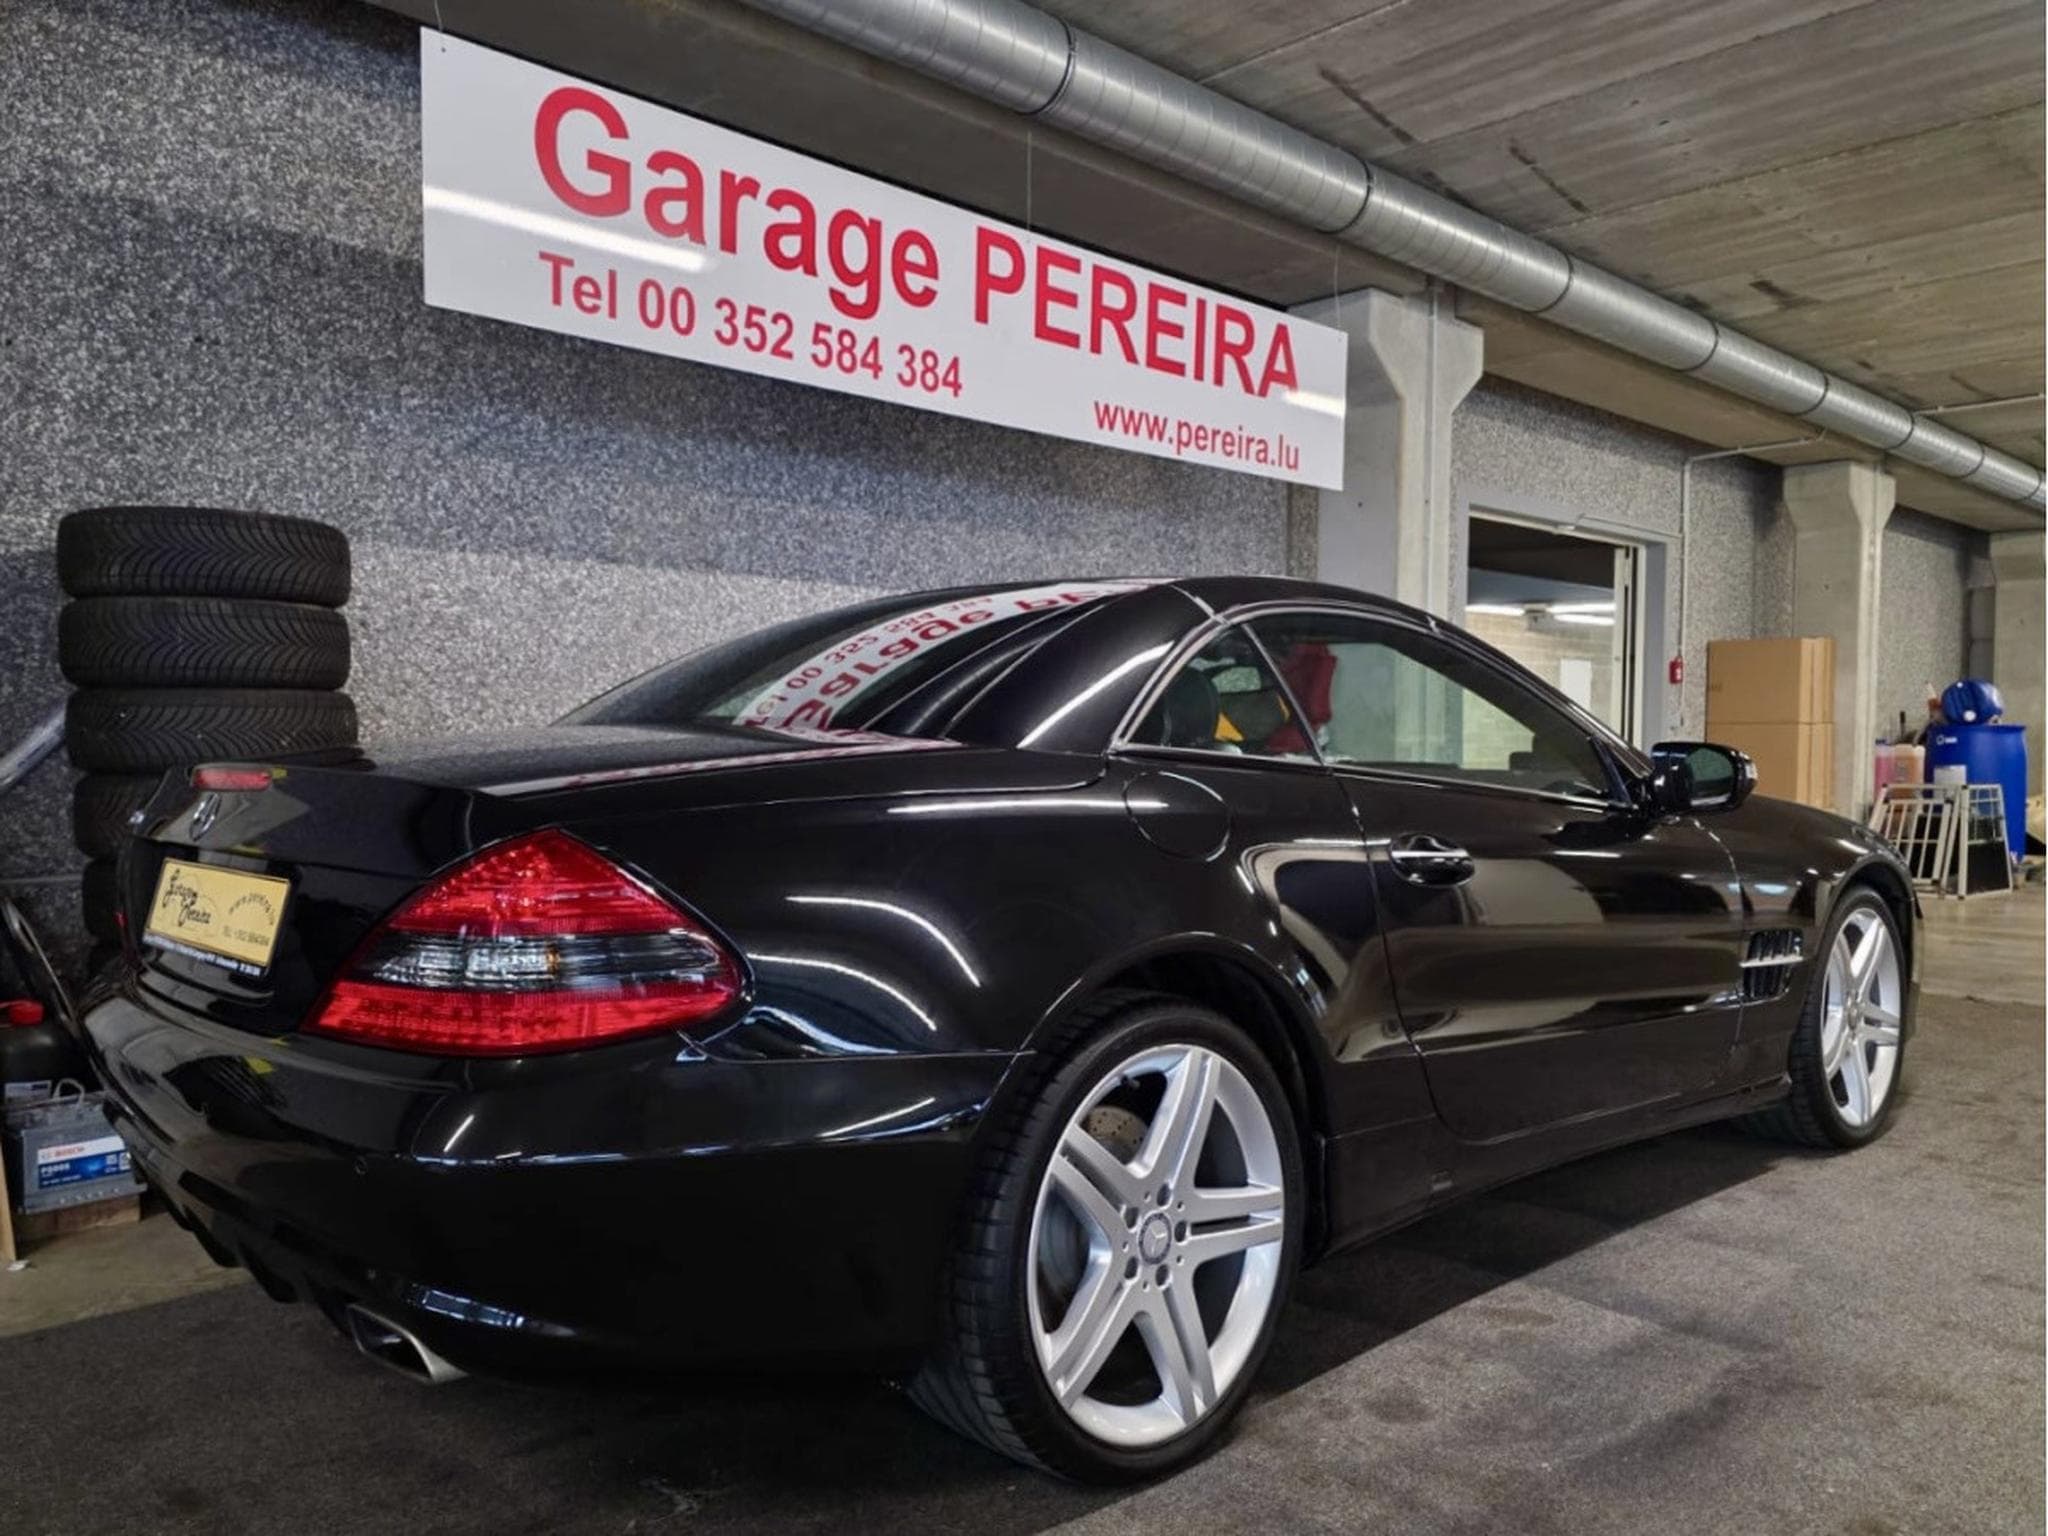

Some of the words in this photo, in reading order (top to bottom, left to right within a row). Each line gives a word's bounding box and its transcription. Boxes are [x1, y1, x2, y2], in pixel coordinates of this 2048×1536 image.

[533, 85, 941, 322] Garage
[973, 225, 1300, 398] PEREIRA
[539, 251, 618, 320] Tel
[637, 279, 697, 337] 00
[714, 297, 795, 361] 352
[810, 322, 884, 380] 584
[897, 343, 964, 397] 384
[1094, 402, 1301, 471] www.pereira.lu
